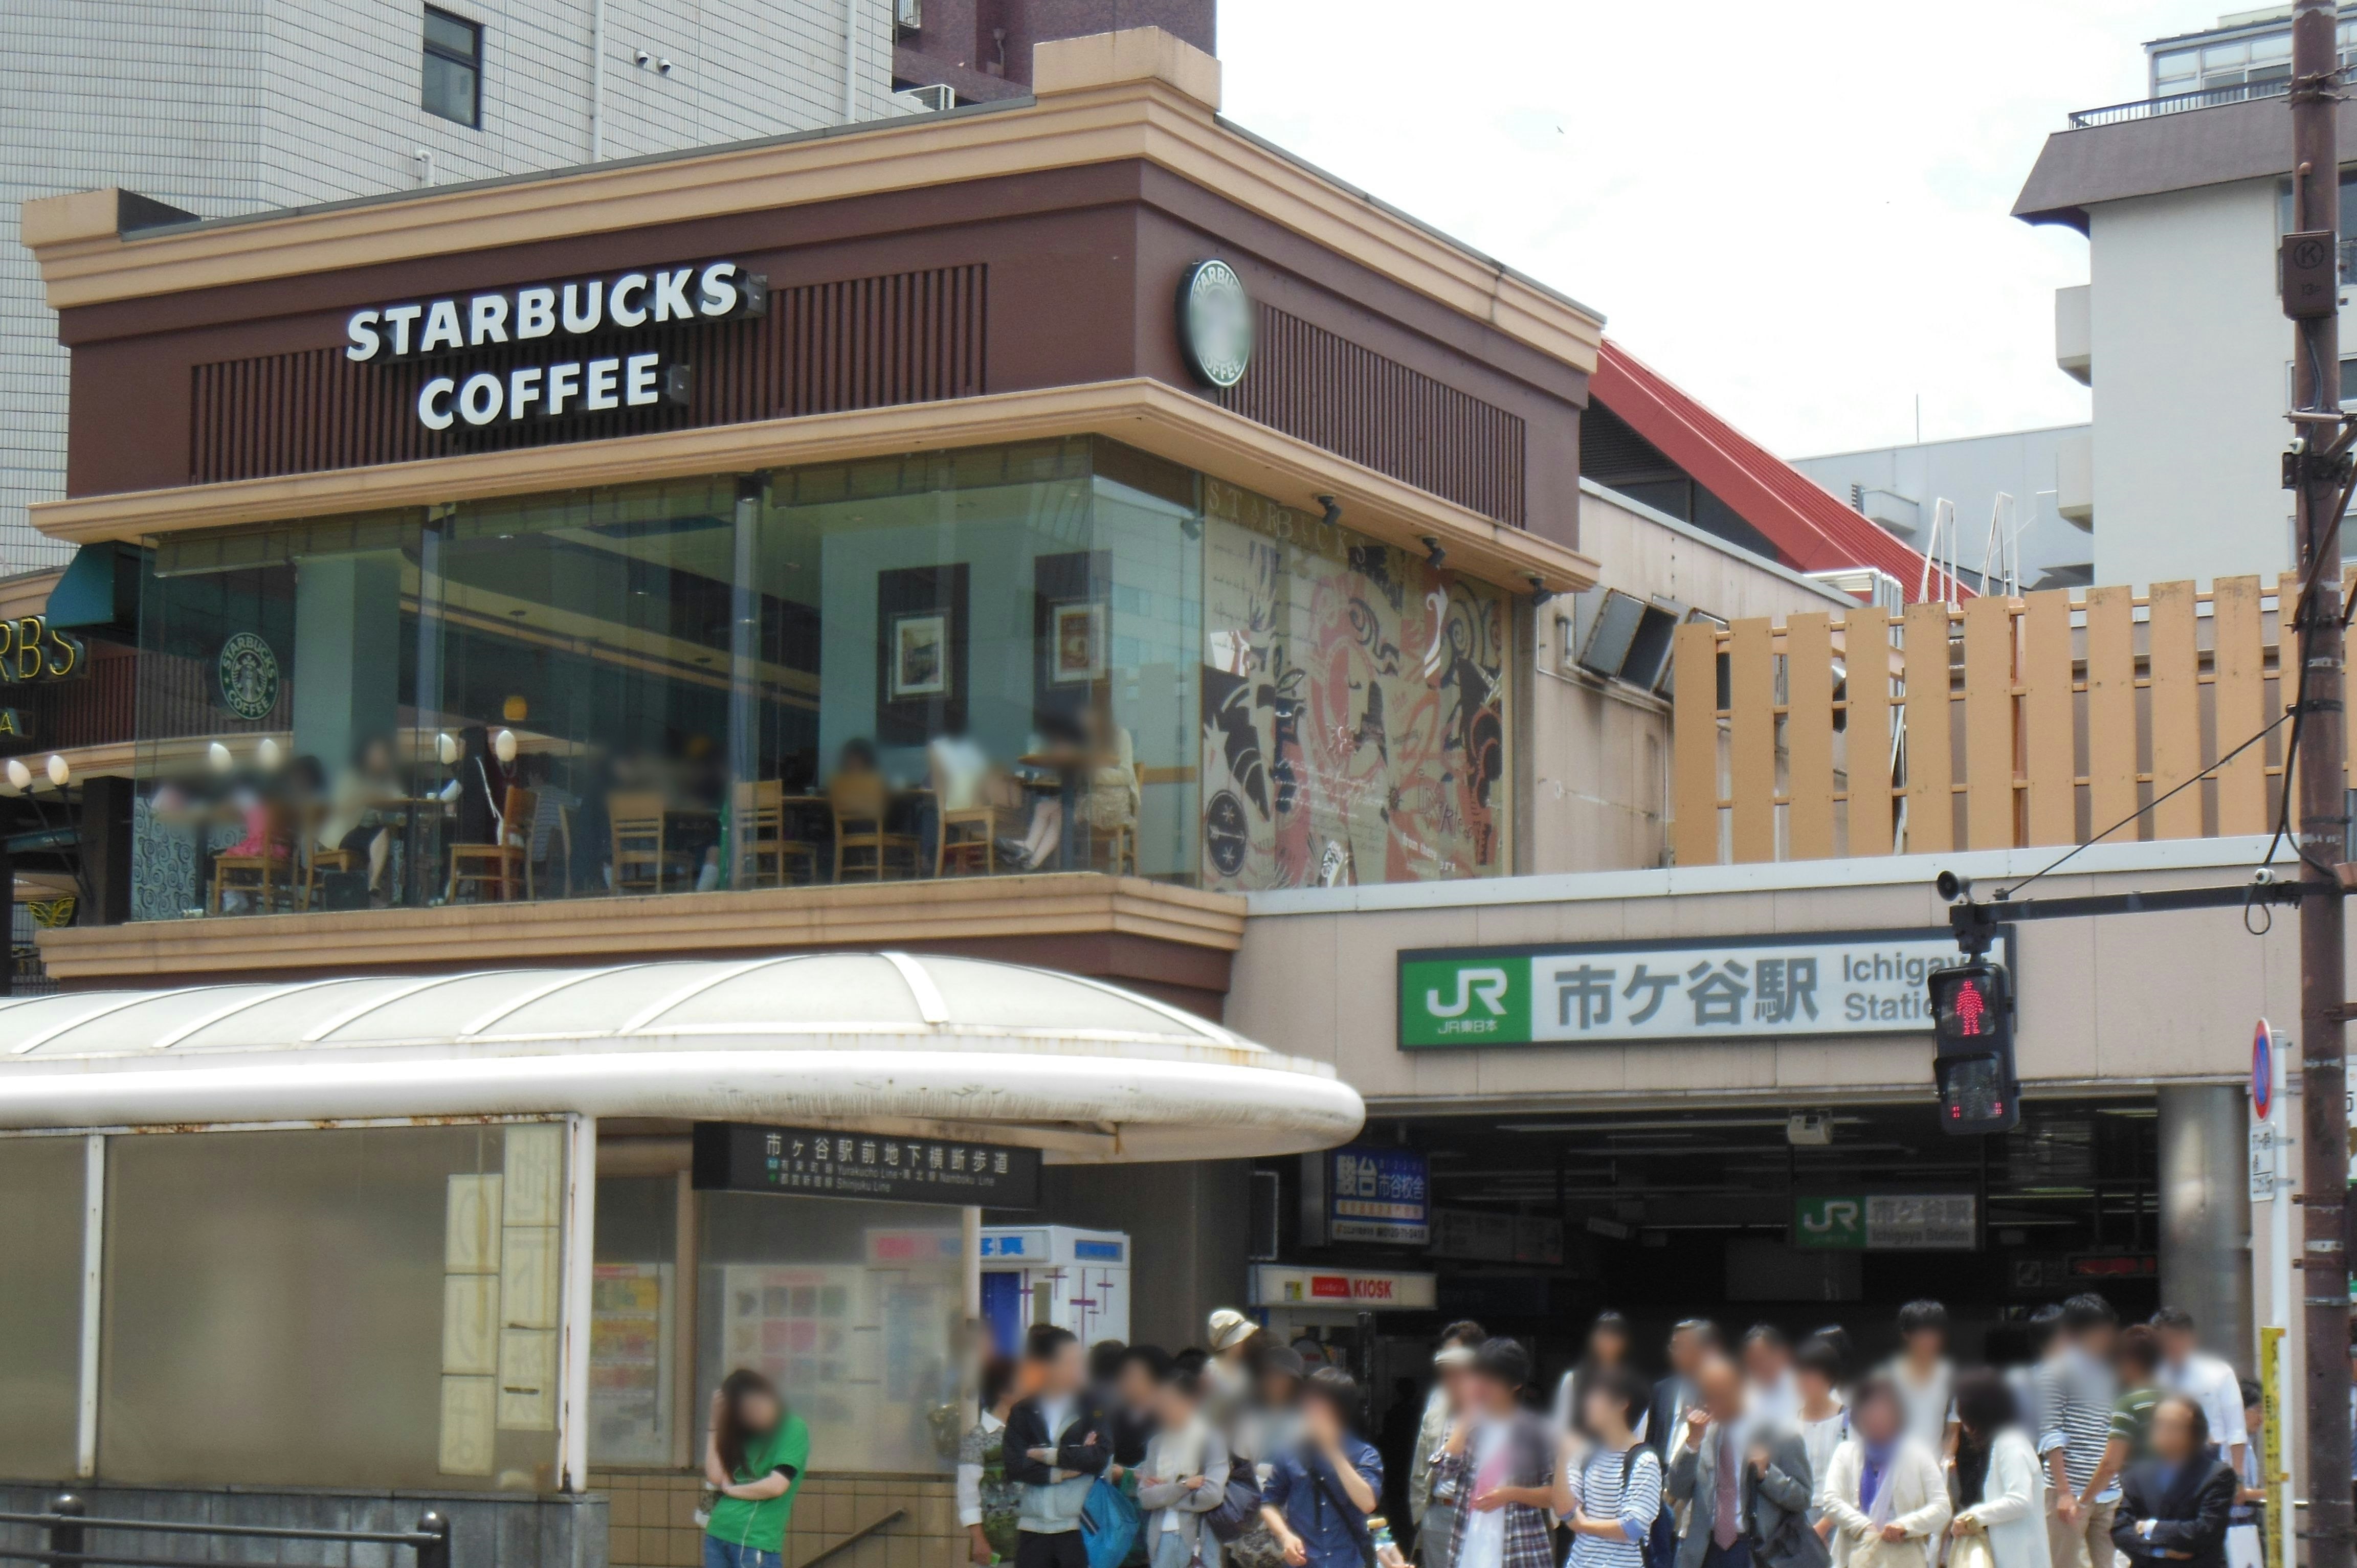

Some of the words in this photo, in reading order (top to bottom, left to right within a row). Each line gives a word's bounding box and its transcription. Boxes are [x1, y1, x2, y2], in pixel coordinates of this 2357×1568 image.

[346, 263, 738, 362] STARBUCKS
[1204, 353, 1241, 379] OFFEE
[418, 353, 659, 431] COFFEE
[223, 637, 275, 678] STARBUCKS
[228, 689, 269, 715] COFFEE
[1426, 968, 1508, 1018] JR
[1844, 991, 1932, 1021] Stati
[1803, 1201, 1858, 1233] JR
[1872, 1228, 1922, 1244] Ichigaya
[1354, 1280, 1392, 1298] KIOSK
